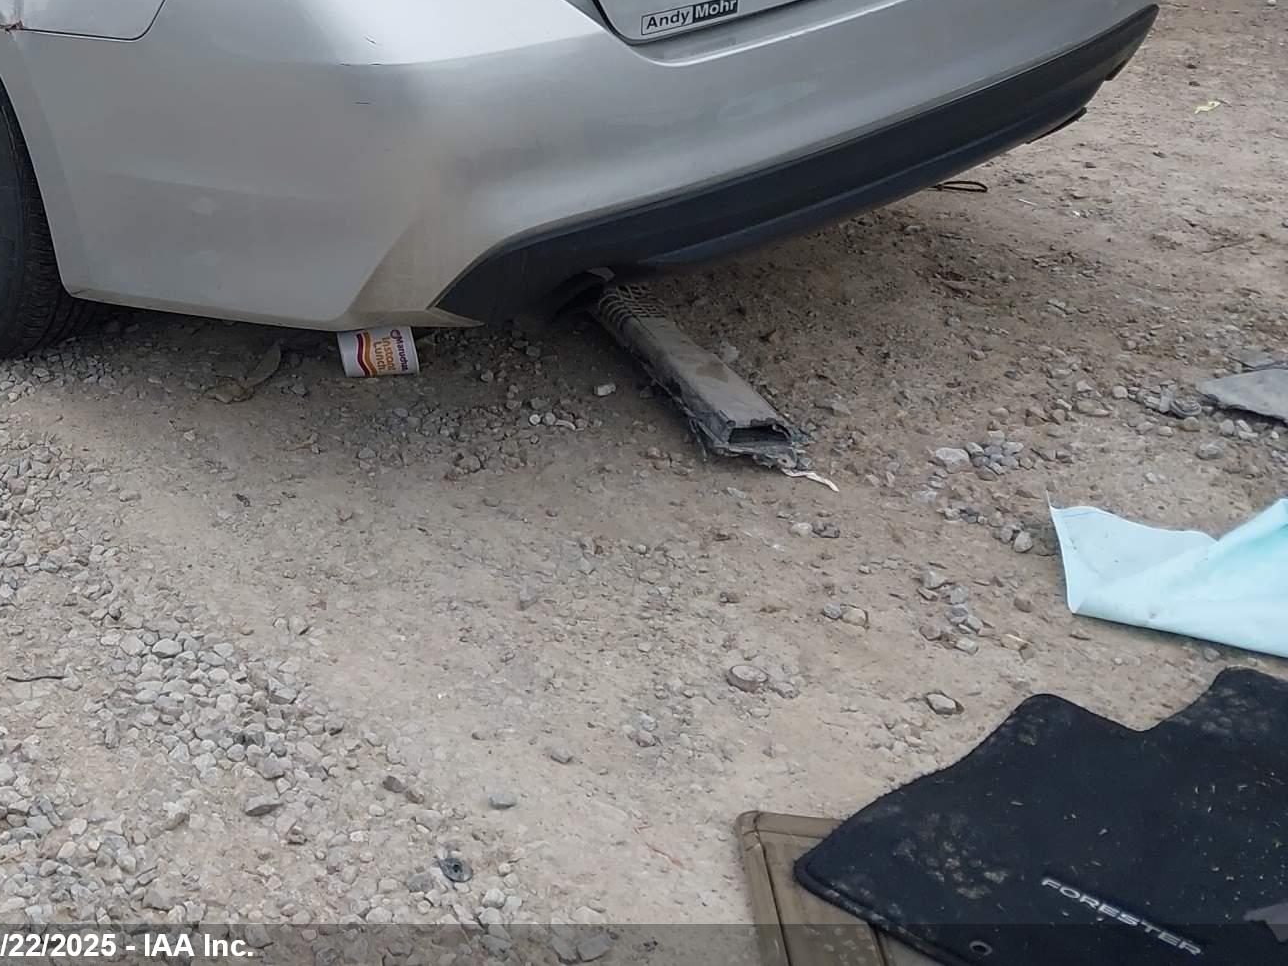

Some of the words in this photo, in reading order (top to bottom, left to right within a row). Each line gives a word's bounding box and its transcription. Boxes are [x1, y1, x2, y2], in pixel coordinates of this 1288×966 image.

[645, 9, 690, 30] Andy
[373, 340, 386, 370] Lunch
[1041, 876, 1203, 956] FORESTER
